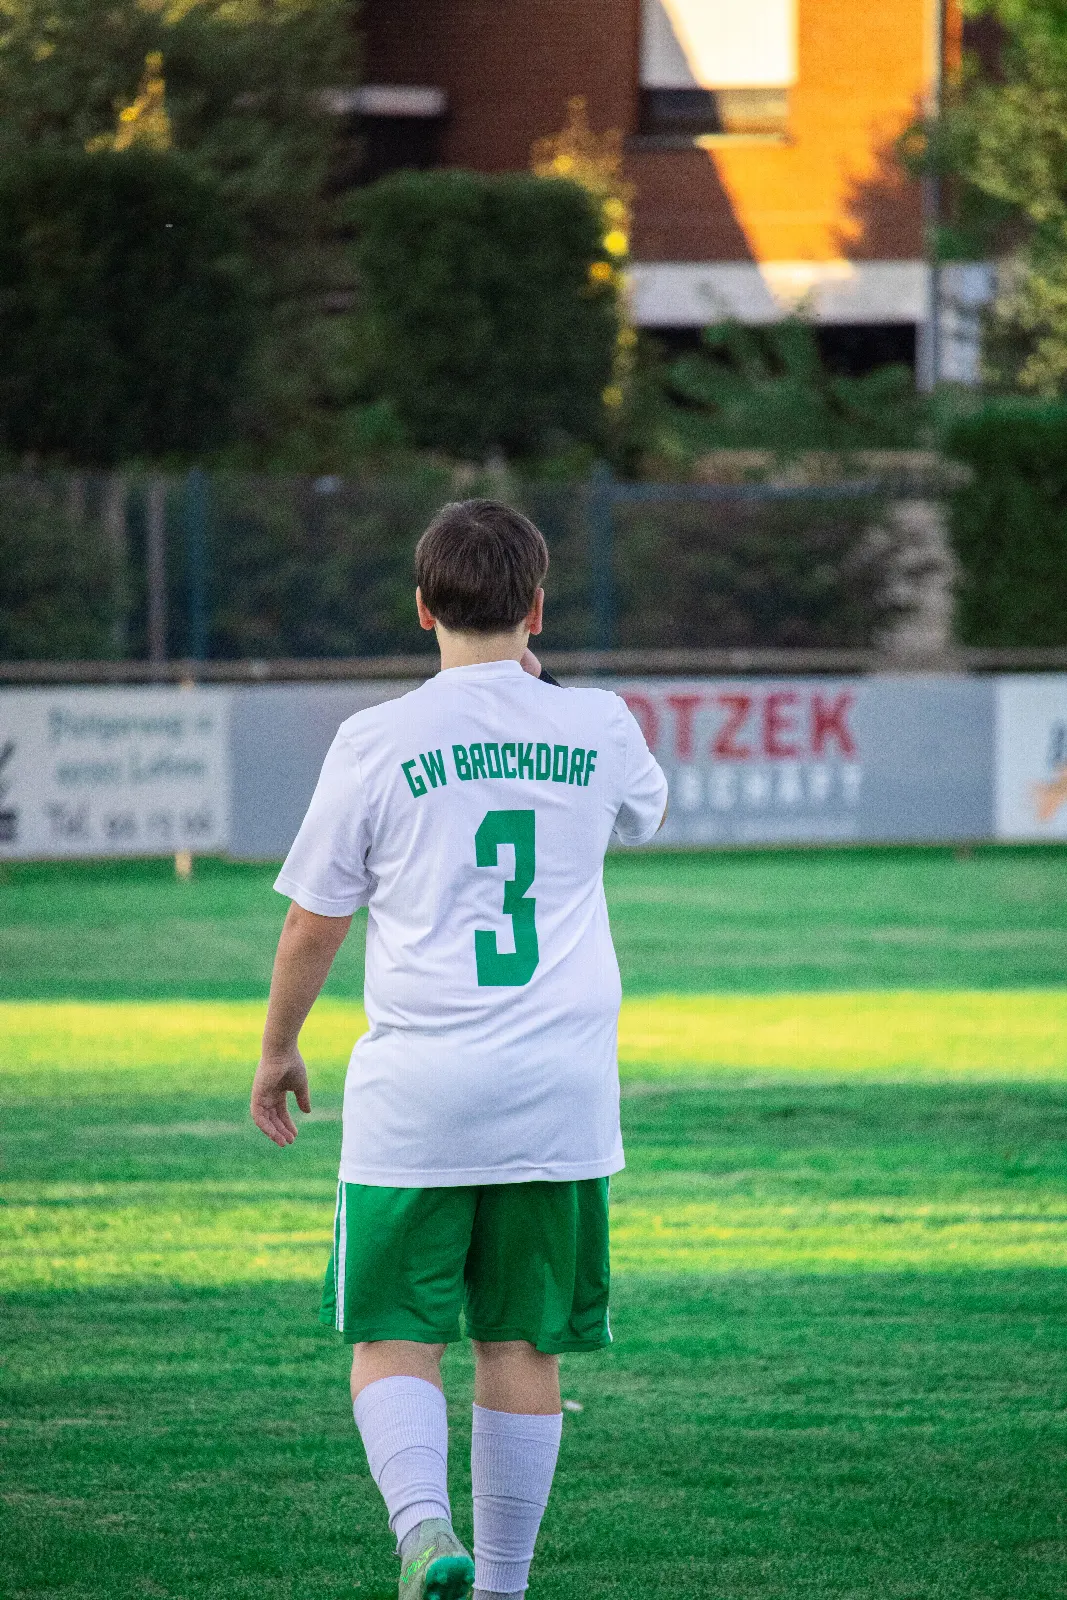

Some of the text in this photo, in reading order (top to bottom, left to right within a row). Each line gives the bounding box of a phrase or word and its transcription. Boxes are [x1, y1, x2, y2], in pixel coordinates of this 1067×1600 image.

[401, 742, 597, 798] GW BROCKDORF
[474, 809, 540, 987] 3
